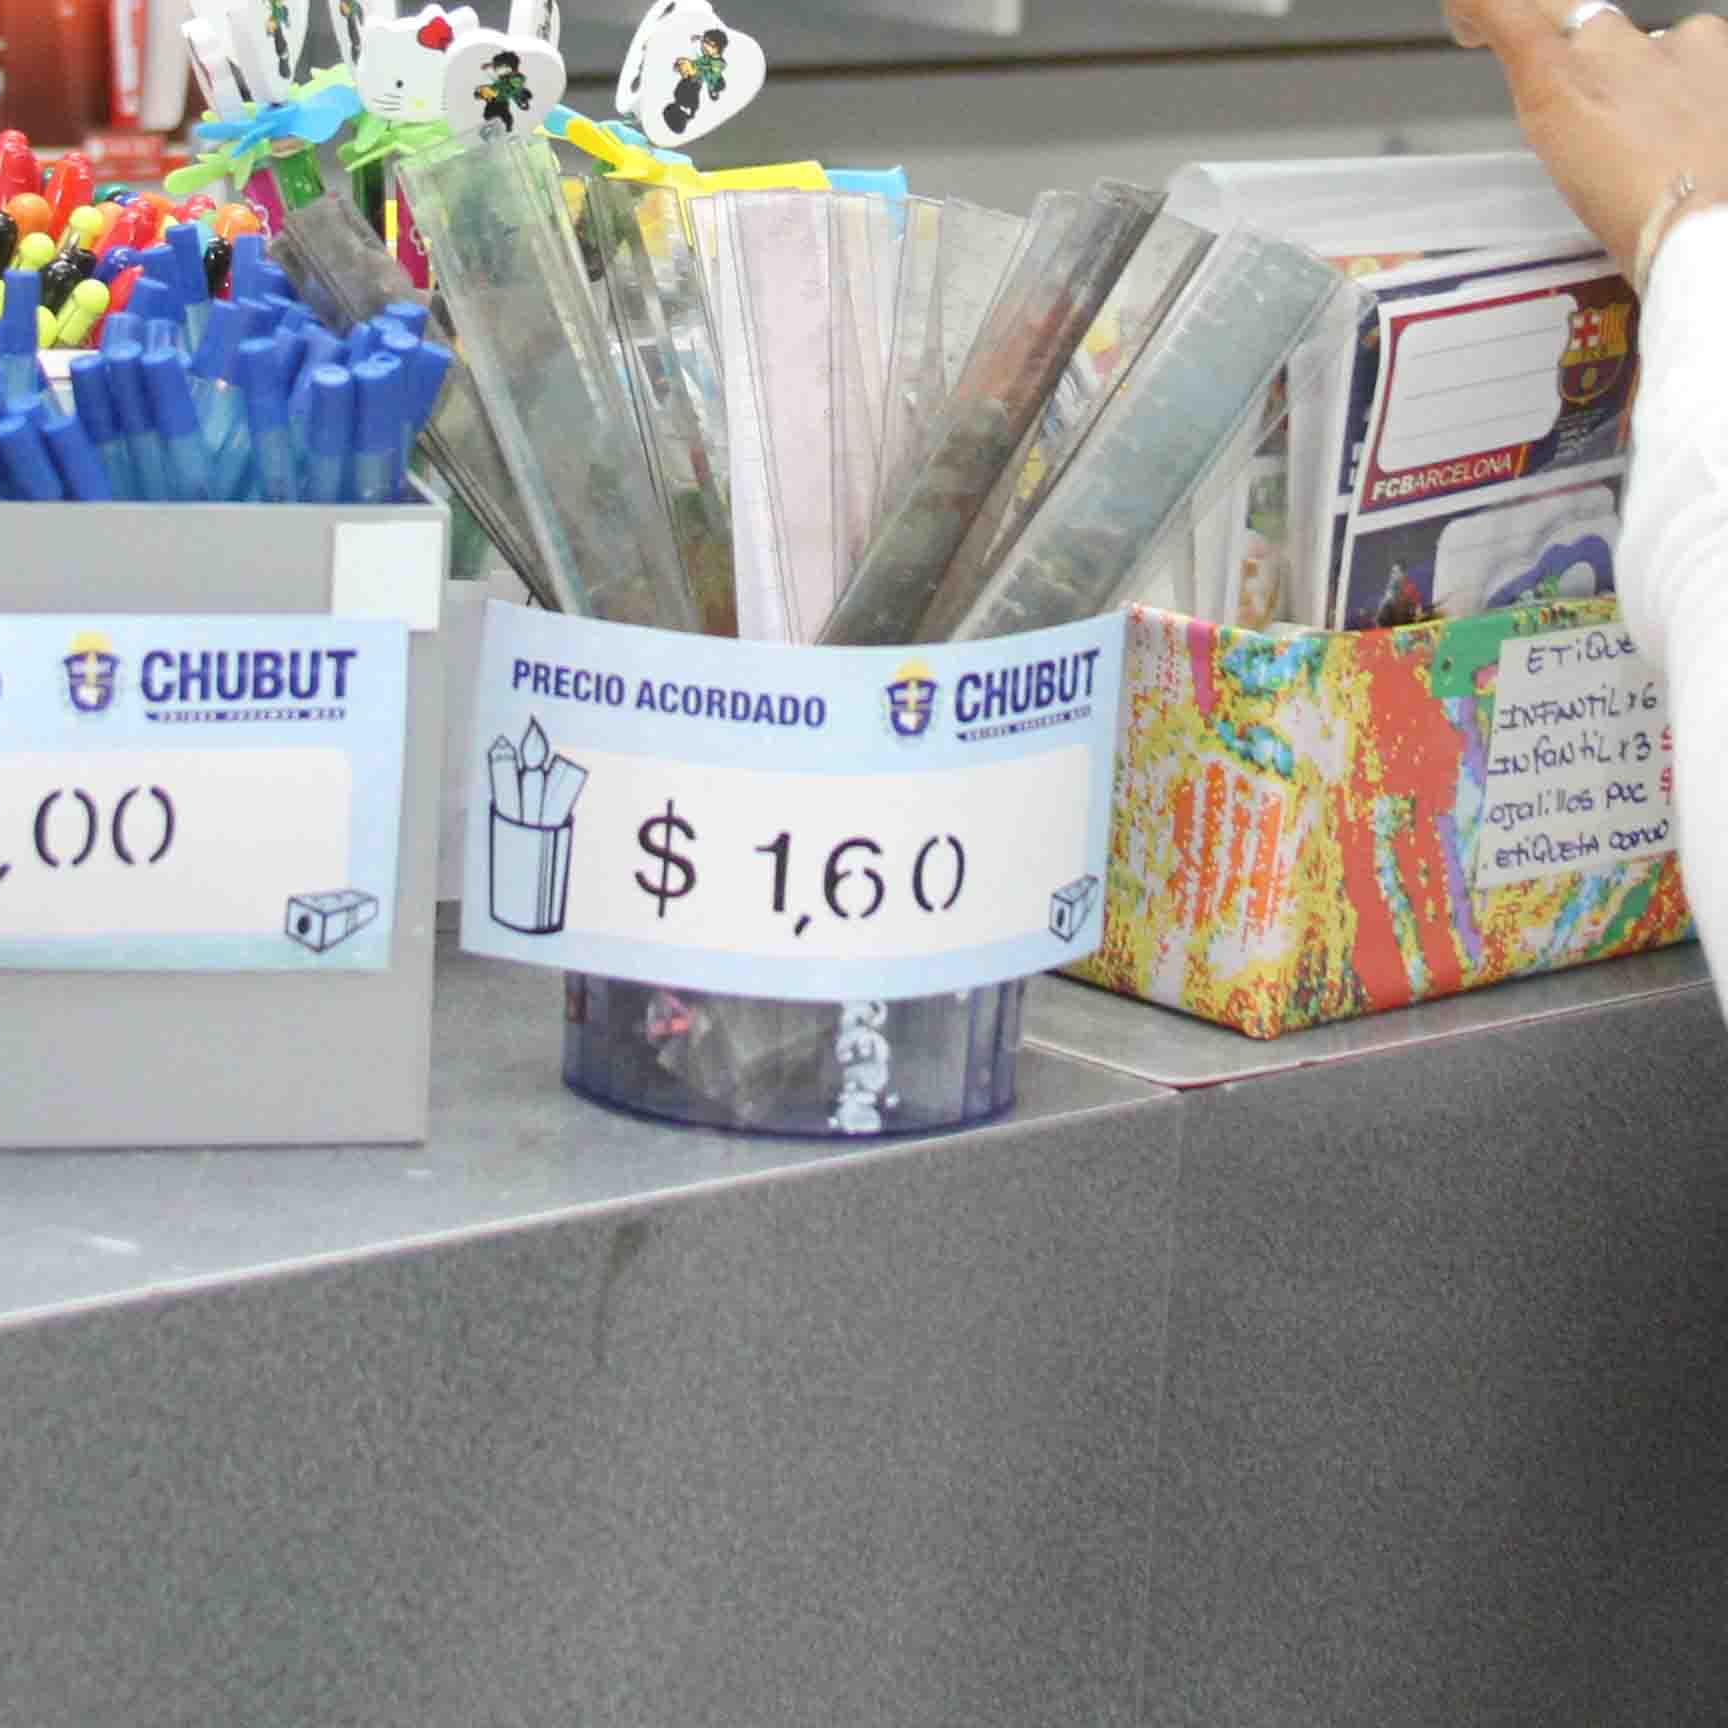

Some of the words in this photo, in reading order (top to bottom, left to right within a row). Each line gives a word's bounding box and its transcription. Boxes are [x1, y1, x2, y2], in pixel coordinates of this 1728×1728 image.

[140, 650, 357, 703] CHUBUT
[512, 658, 626, 706] PRECIO
[635, 679, 827, 729] ACORDADO
[954, 647, 1101, 724] CHUBUT
[634, 800, 696, 918] $
[755, 831, 966, 937] 1,60
